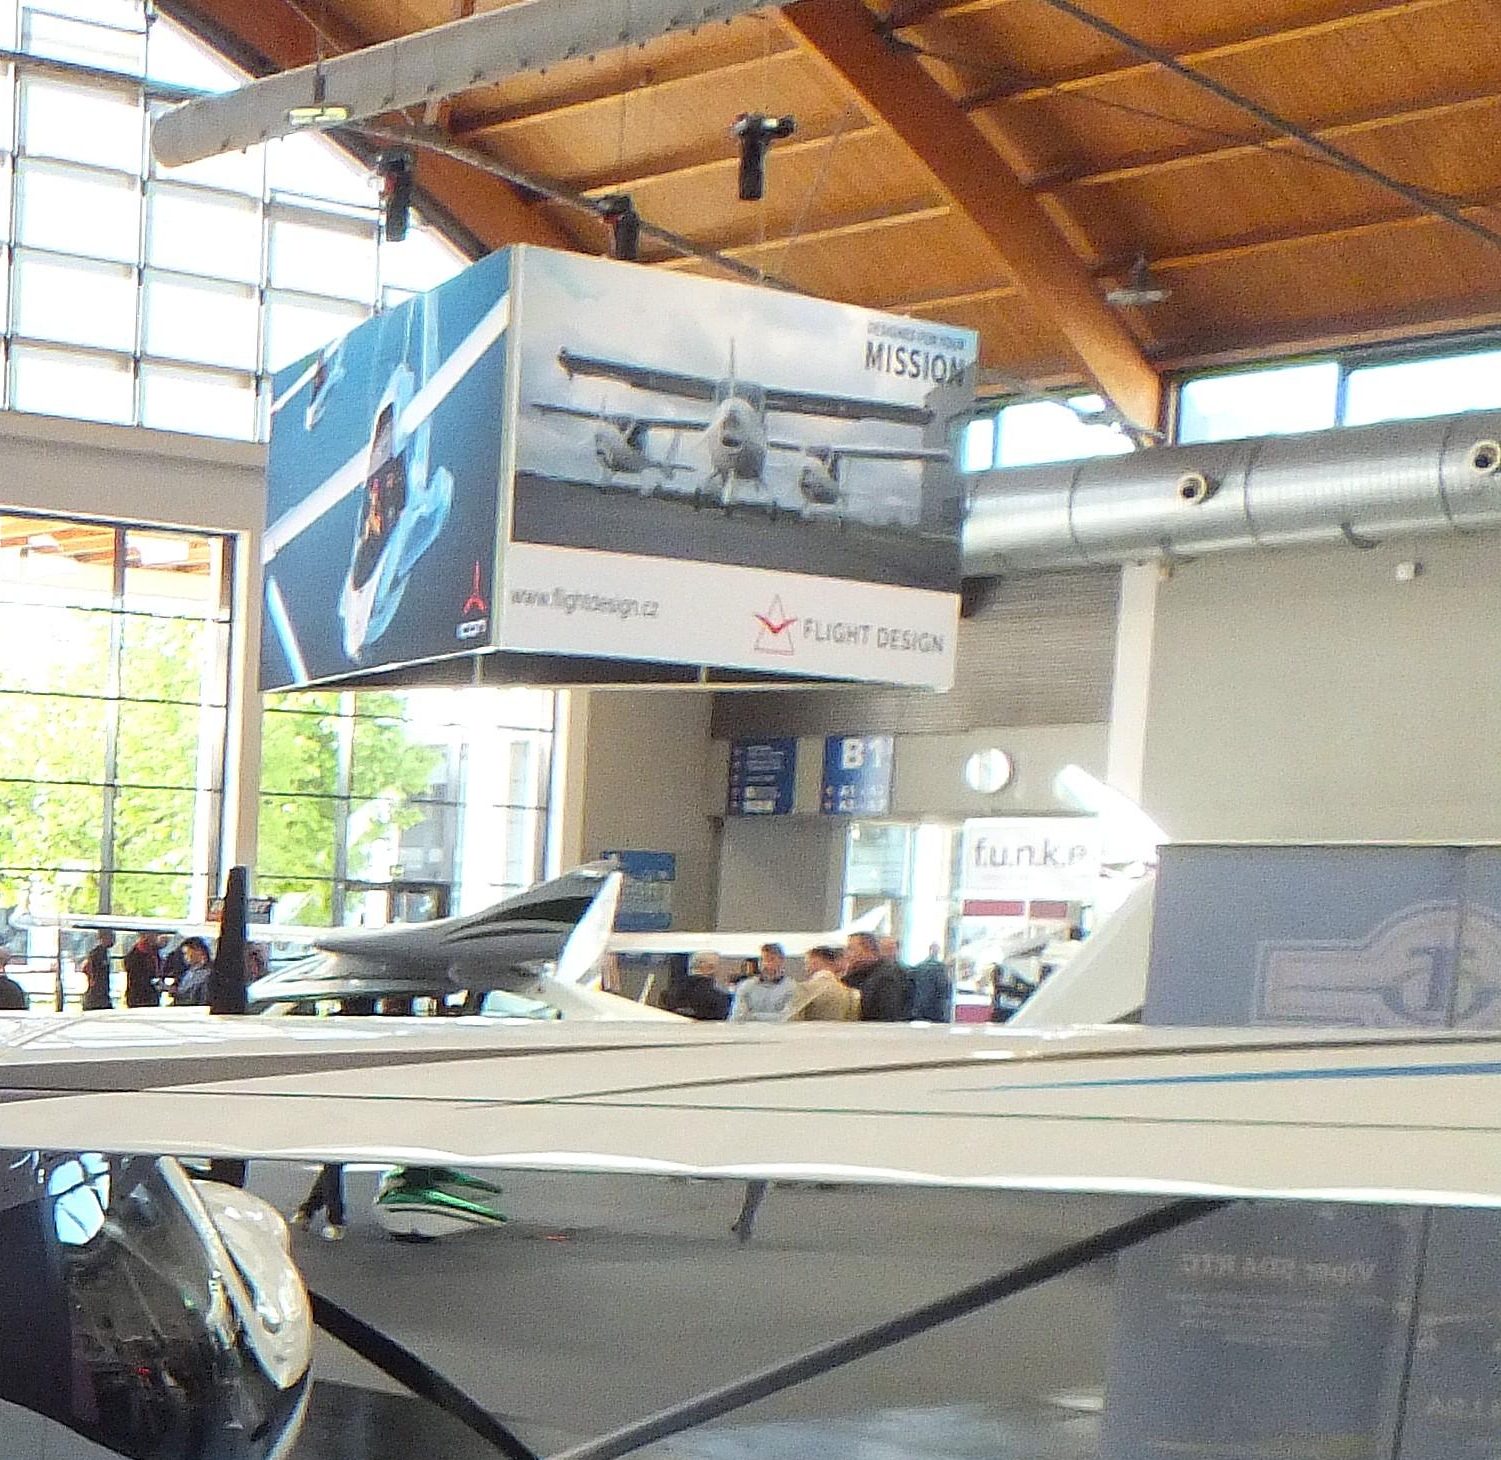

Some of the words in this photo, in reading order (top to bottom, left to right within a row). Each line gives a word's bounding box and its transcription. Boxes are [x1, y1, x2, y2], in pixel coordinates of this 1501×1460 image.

[865, 340, 965, 385] MISSION
[803, 618, 871, 645] FLIGHT
[876, 627, 945, 652] DESIGN
